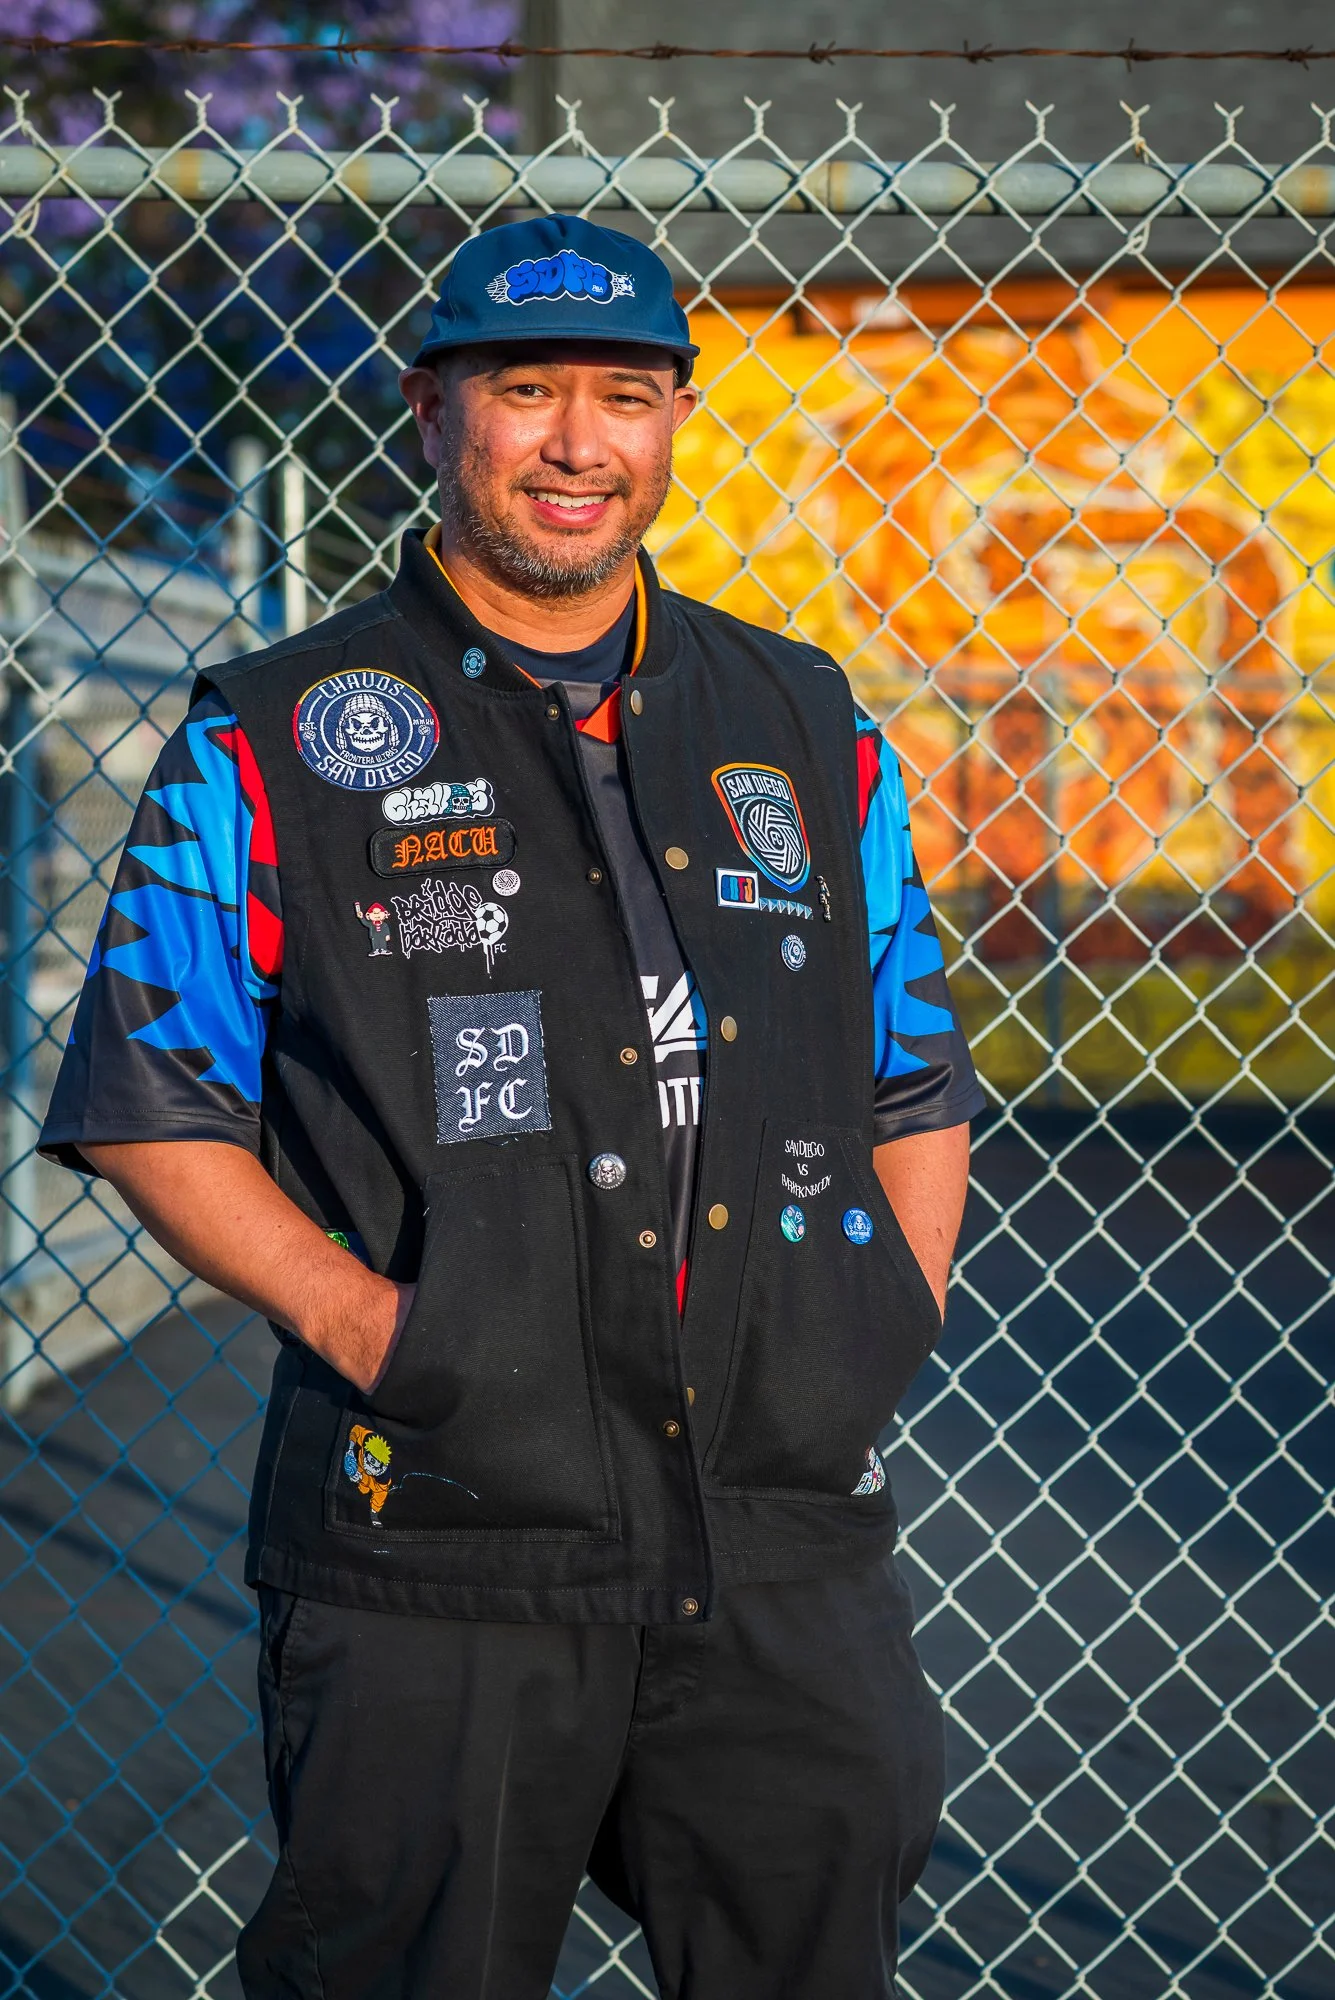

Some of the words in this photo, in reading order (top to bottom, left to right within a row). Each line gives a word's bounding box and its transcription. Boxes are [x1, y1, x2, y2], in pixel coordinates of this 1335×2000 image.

[299, 721, 318, 731] EST.
[316, 754, 358, 787] SAN
[365, 750, 424, 788] DIEGO
[339, 749, 376, 765] FRONTERA
[374, 747, 399, 765] ULTRAS
[725, 773, 756, 799] SAN
[750, 774, 790, 801] DIEGO
[391, 826, 499, 869] NACU
[494, 943, 507, 954] FC
[455, 1022, 529, 1077] SD
[455, 1077, 532, 1132] FC
[796, 1162, 809, 1176] VS
